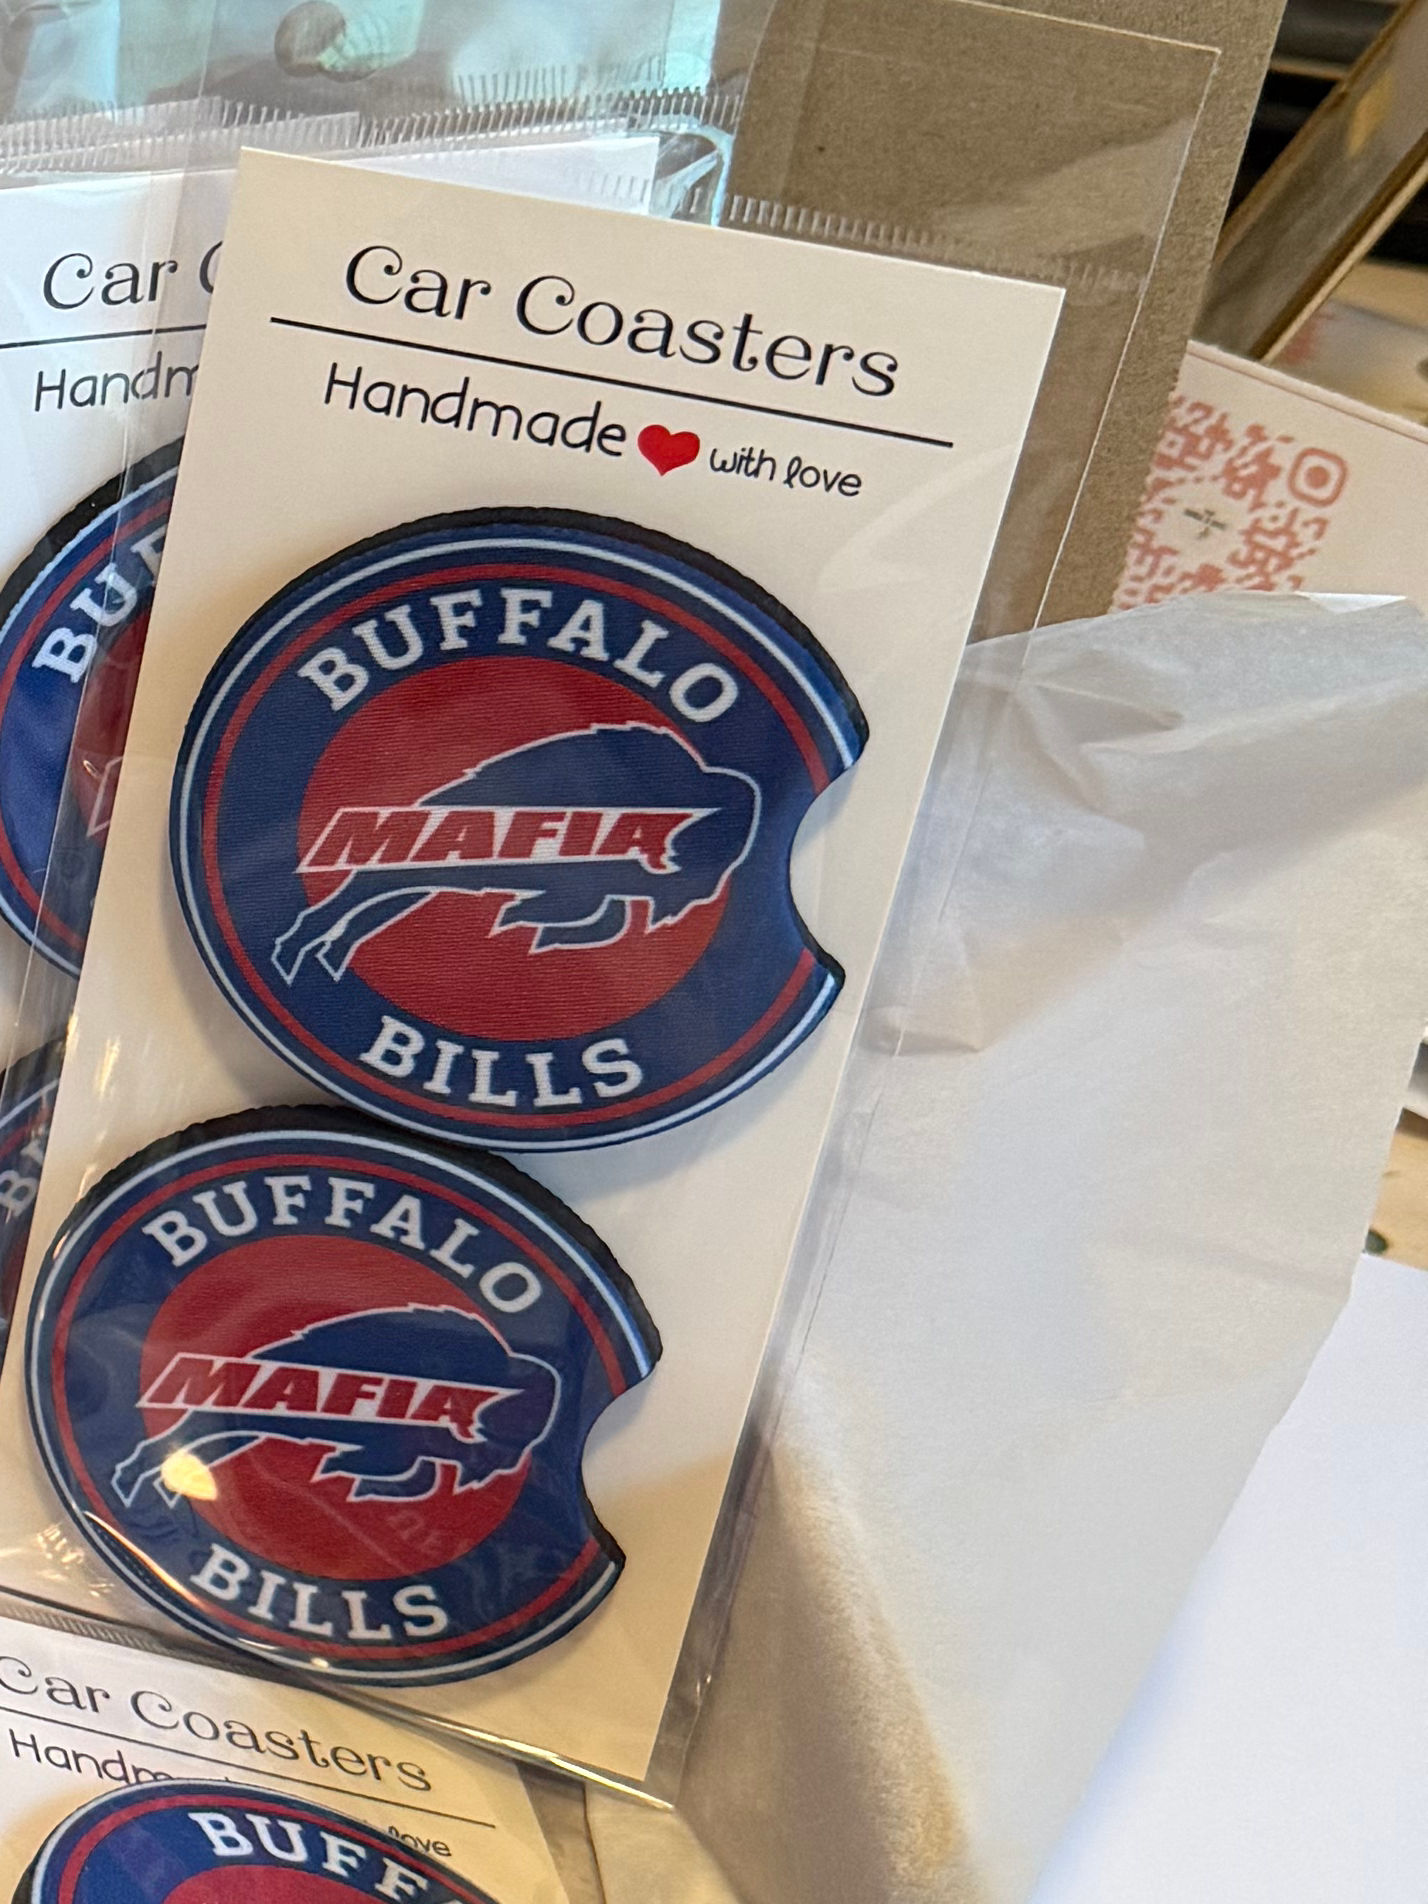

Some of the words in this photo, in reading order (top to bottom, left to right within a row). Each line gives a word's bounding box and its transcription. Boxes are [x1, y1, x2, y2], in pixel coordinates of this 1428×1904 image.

[43, 252, 178, 310] Car
[344, 245, 492, 321] Car
[516, 274, 899, 398] Coasters
[34, 350, 200, 412] Handm
[323, 362, 626, 457] Handmade
[708, 443, 777, 482] with
[783, 456, 863, 498] love
[297, 586, 739, 724] BUFFALO
[301, 809, 680, 873] MAFIA
[359, 1014, 645, 1109] BILLS
[143, 1173, 543, 1314] BUFFALO
[143, 1354, 490, 1442] MAFIA
[189, 1542, 449, 1641] BILLS
[129, 1689, 434, 1794] Coasters
